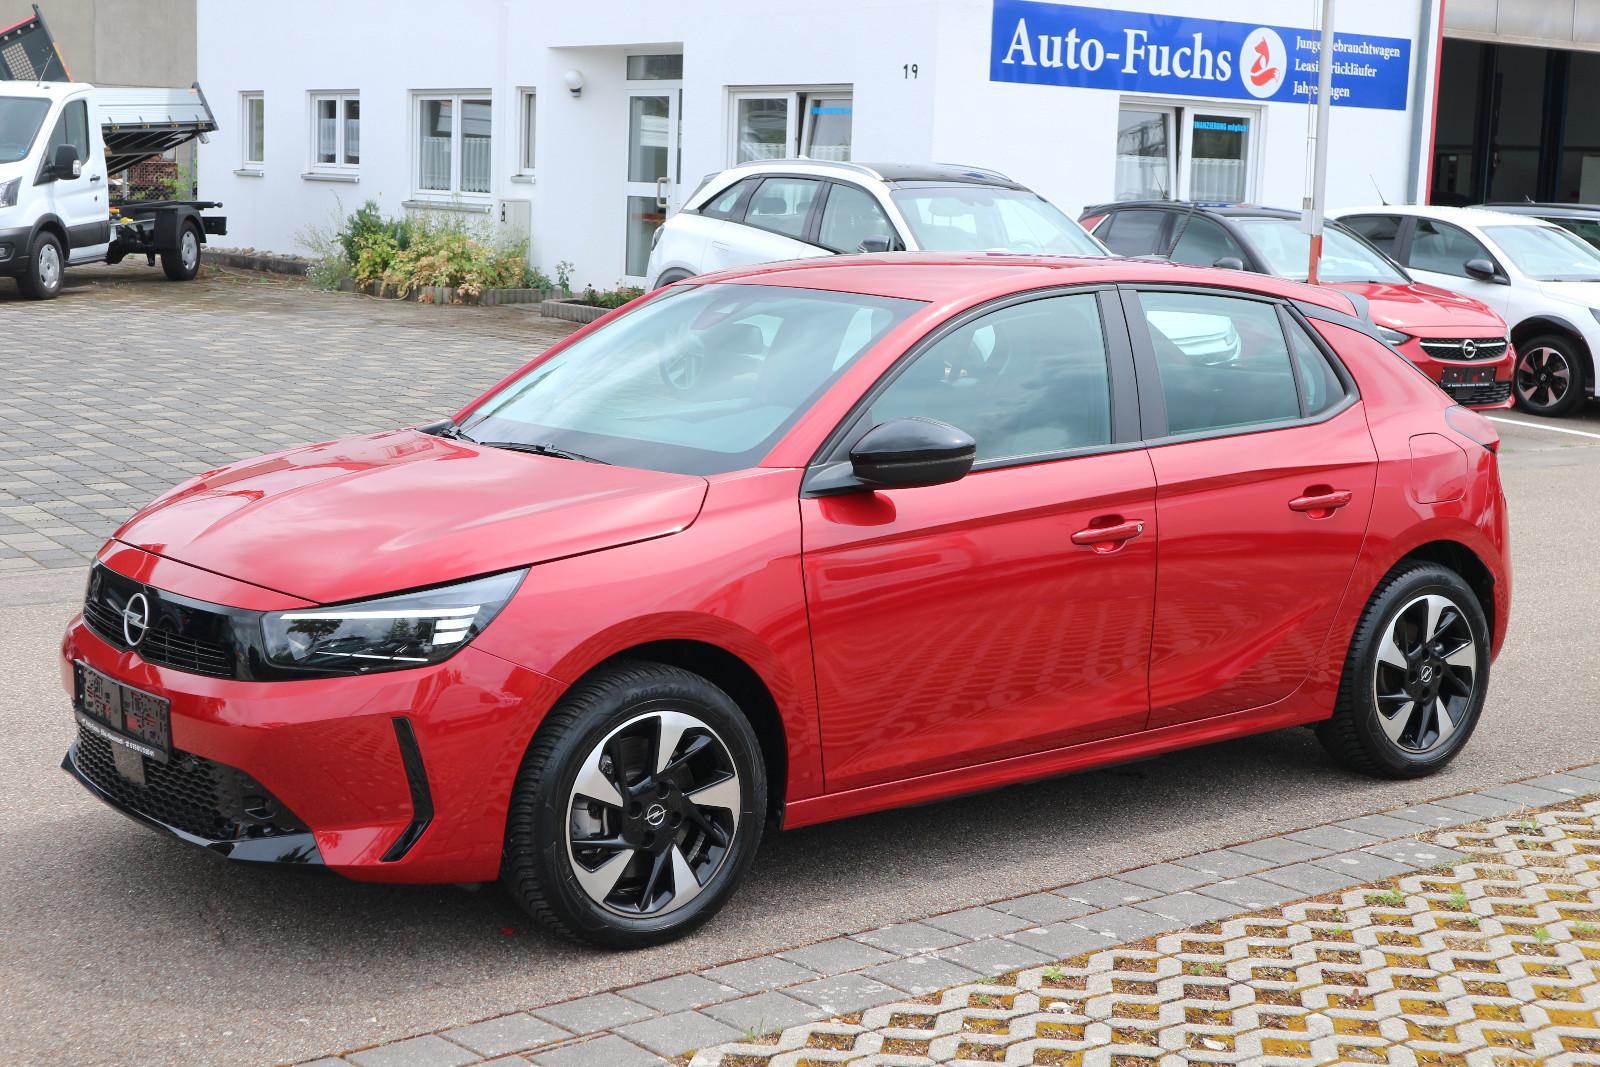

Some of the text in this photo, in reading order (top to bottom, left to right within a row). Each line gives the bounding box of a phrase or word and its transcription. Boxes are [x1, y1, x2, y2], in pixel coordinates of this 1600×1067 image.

[1001, 17, 1232, 82] Auto-Fuchs
[1296, 35, 1400, 60] Junge ebrauchtwagen
[903, 63, 918, 79] 19
[1295, 58, 1377, 77] Leasirückläufer
[1292, 81, 1350, 100] Jahreagen
